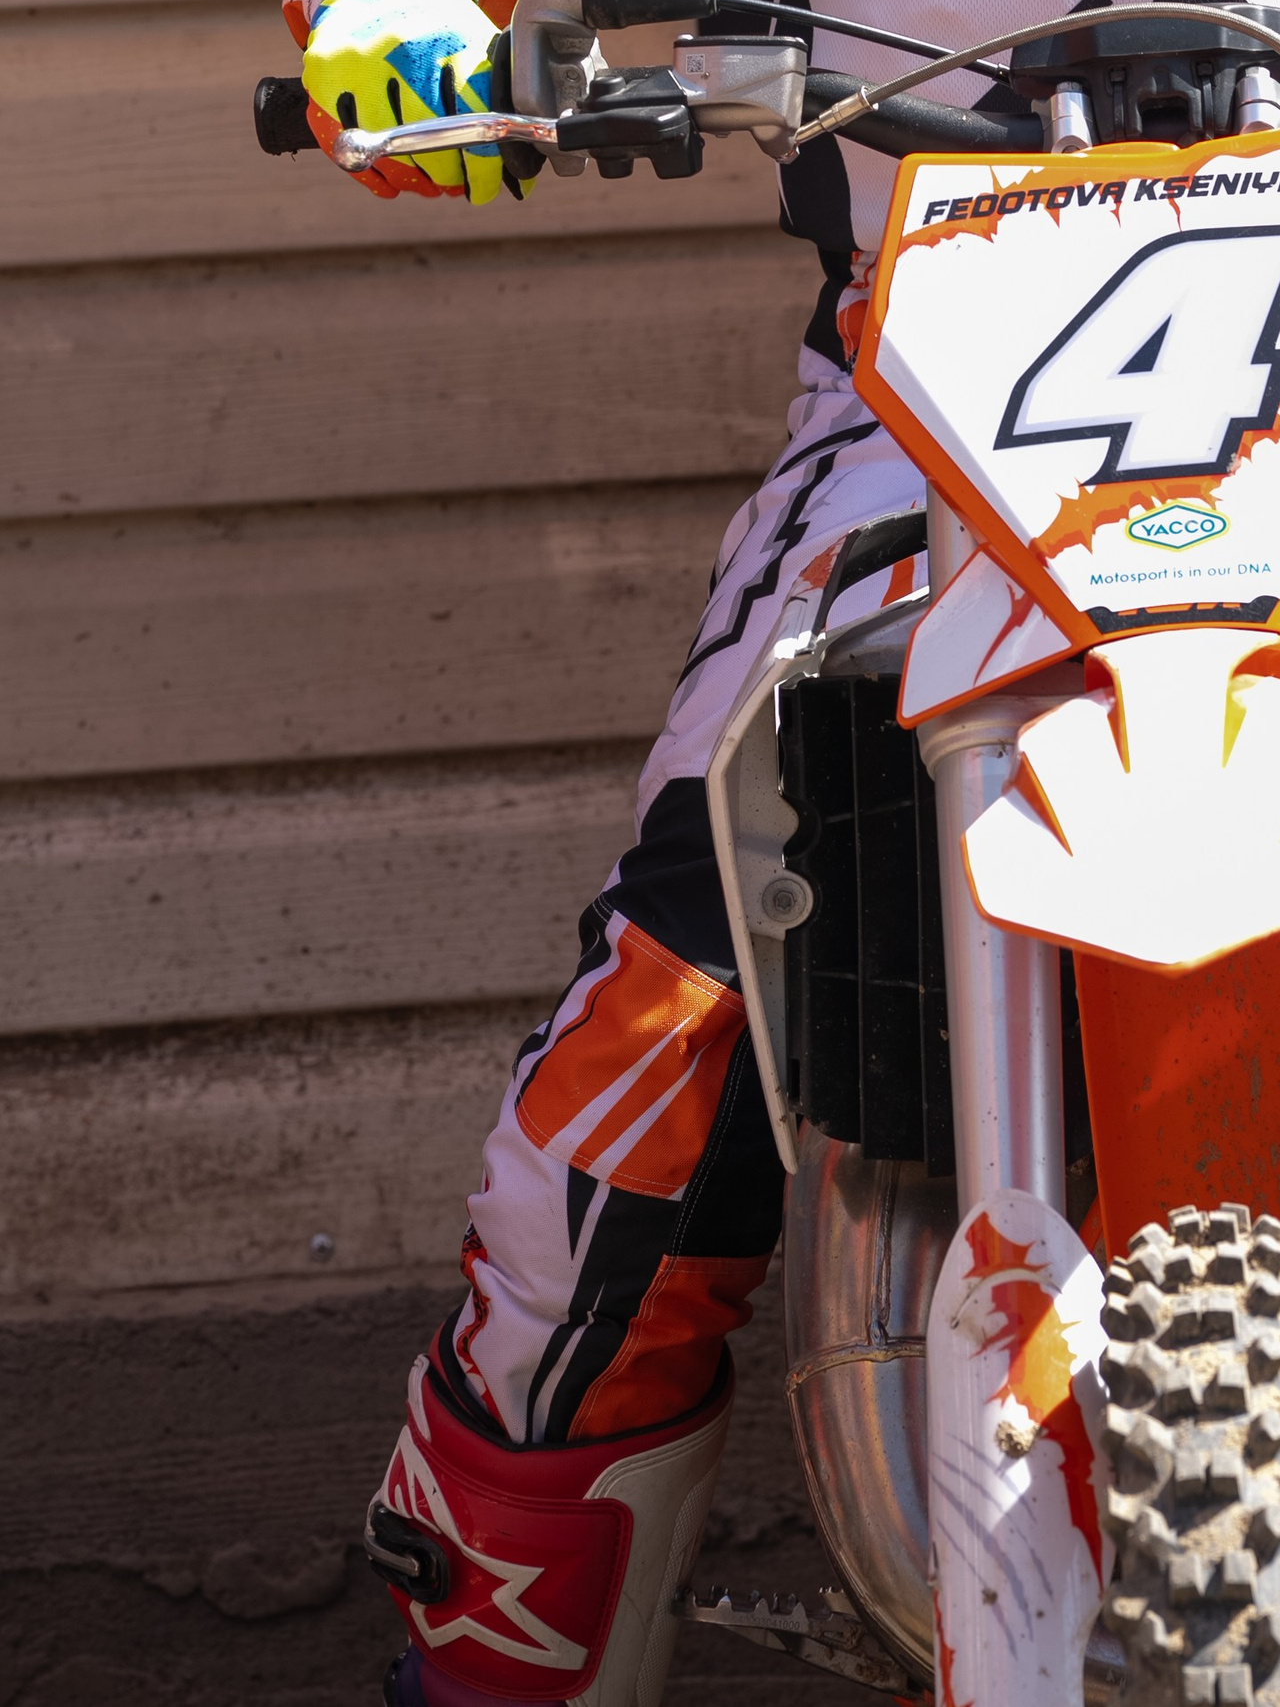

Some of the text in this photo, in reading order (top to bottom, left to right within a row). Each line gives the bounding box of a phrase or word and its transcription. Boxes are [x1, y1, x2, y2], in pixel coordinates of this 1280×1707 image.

[922, 180, 1128, 225] FEDOTOVA
[1141, 519, 1216, 536] YACCO
[1089, 562, 1272, 586] Motosport is in our DNA
